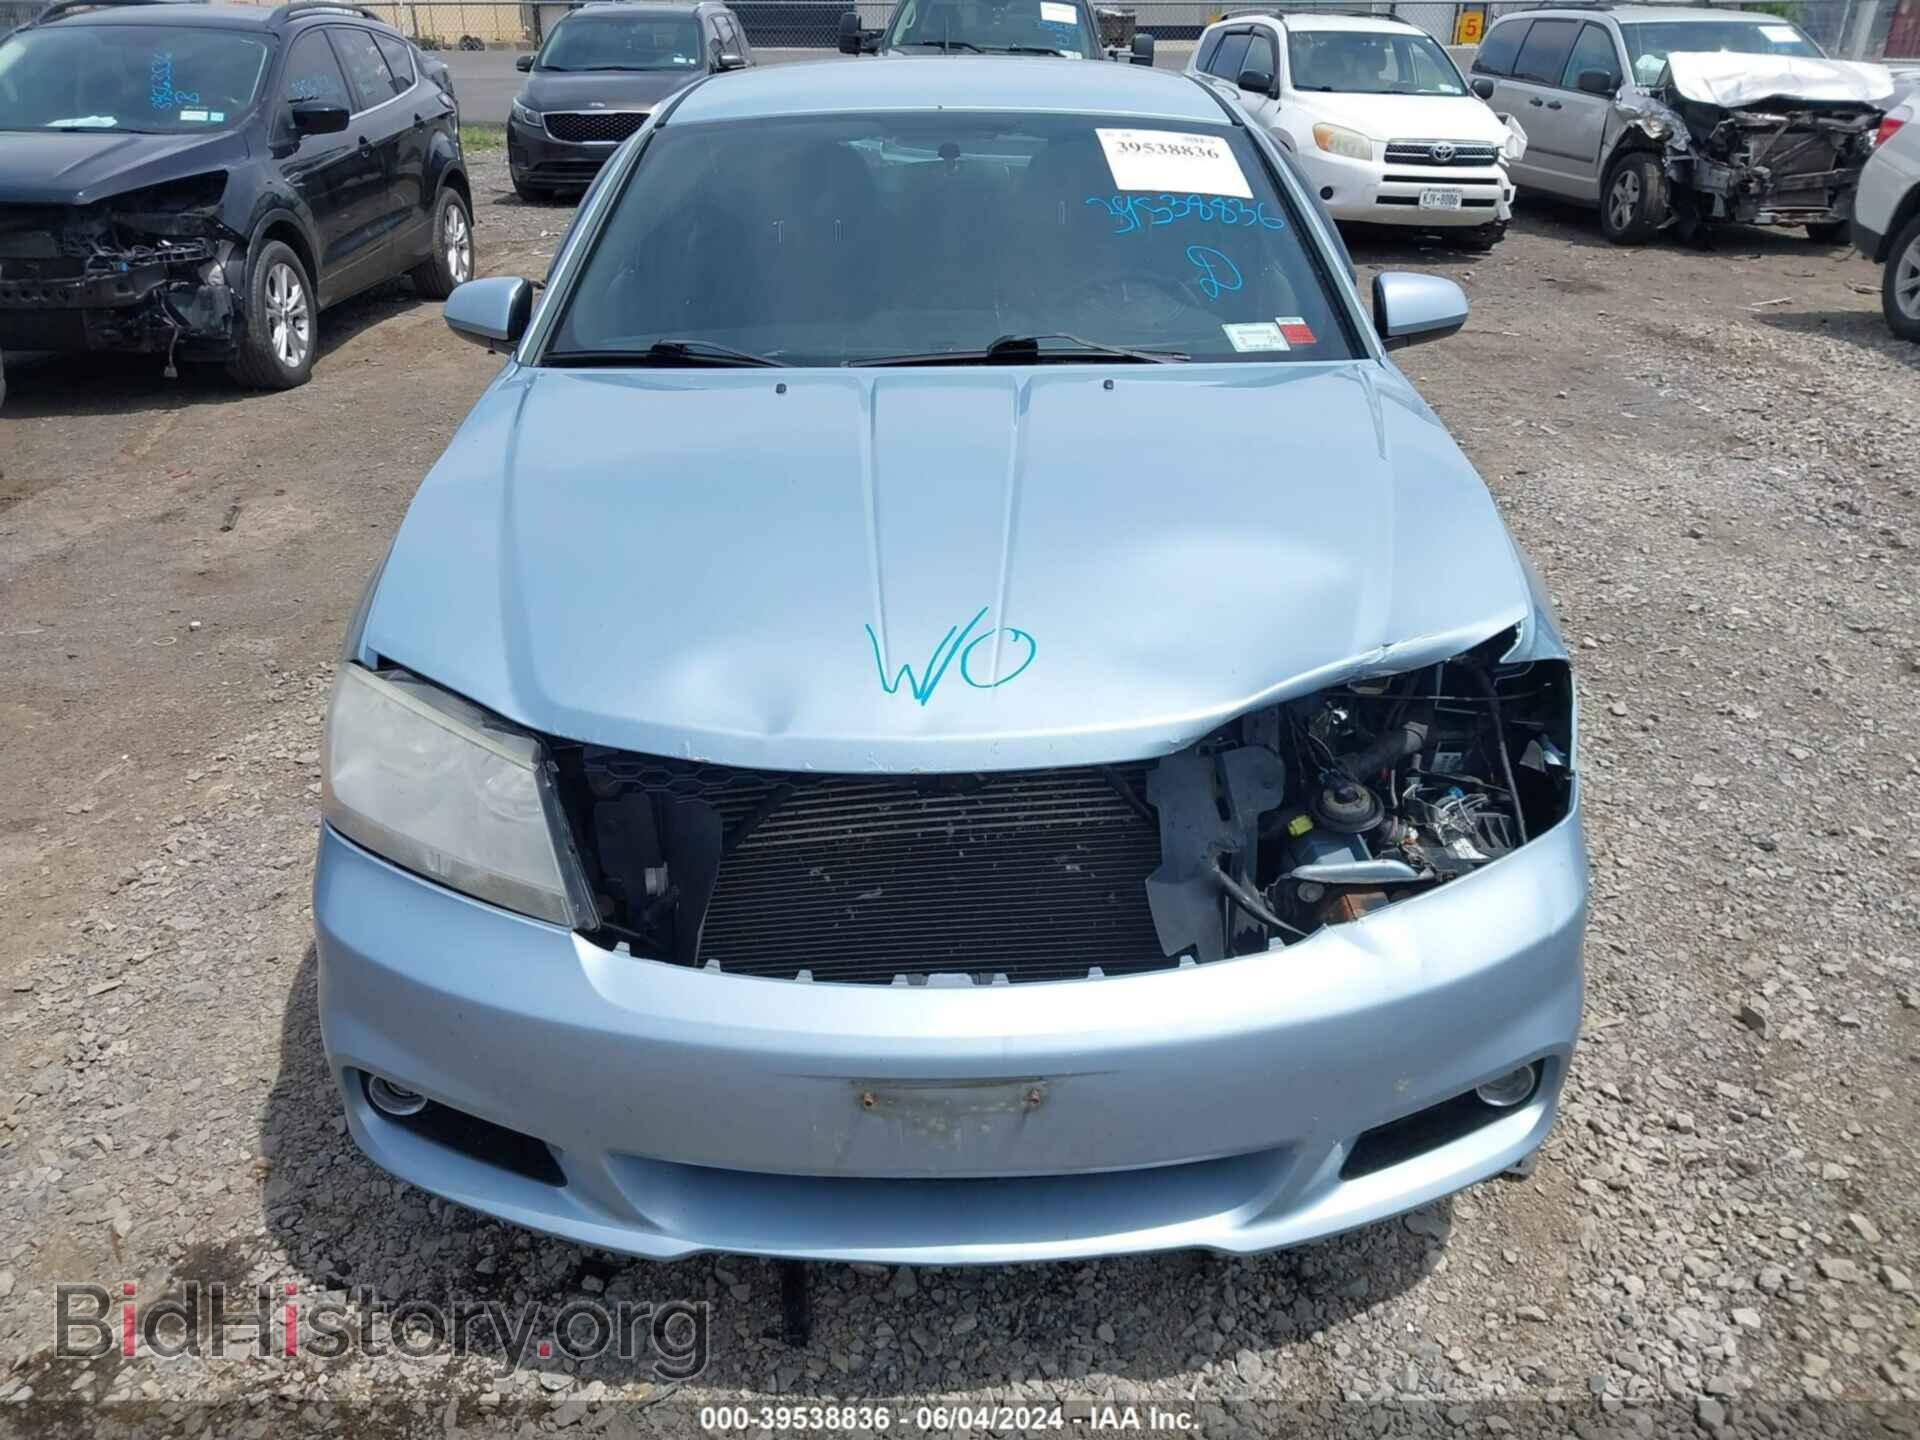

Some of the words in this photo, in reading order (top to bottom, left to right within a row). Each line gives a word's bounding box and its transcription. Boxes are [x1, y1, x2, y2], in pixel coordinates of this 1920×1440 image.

[1465, 18, 1477, 37] 5
[1116, 140, 1220, 160] 39538836
[1086, 193, 1285, 235] 39538836
[865, 606, 1037, 707] WO
